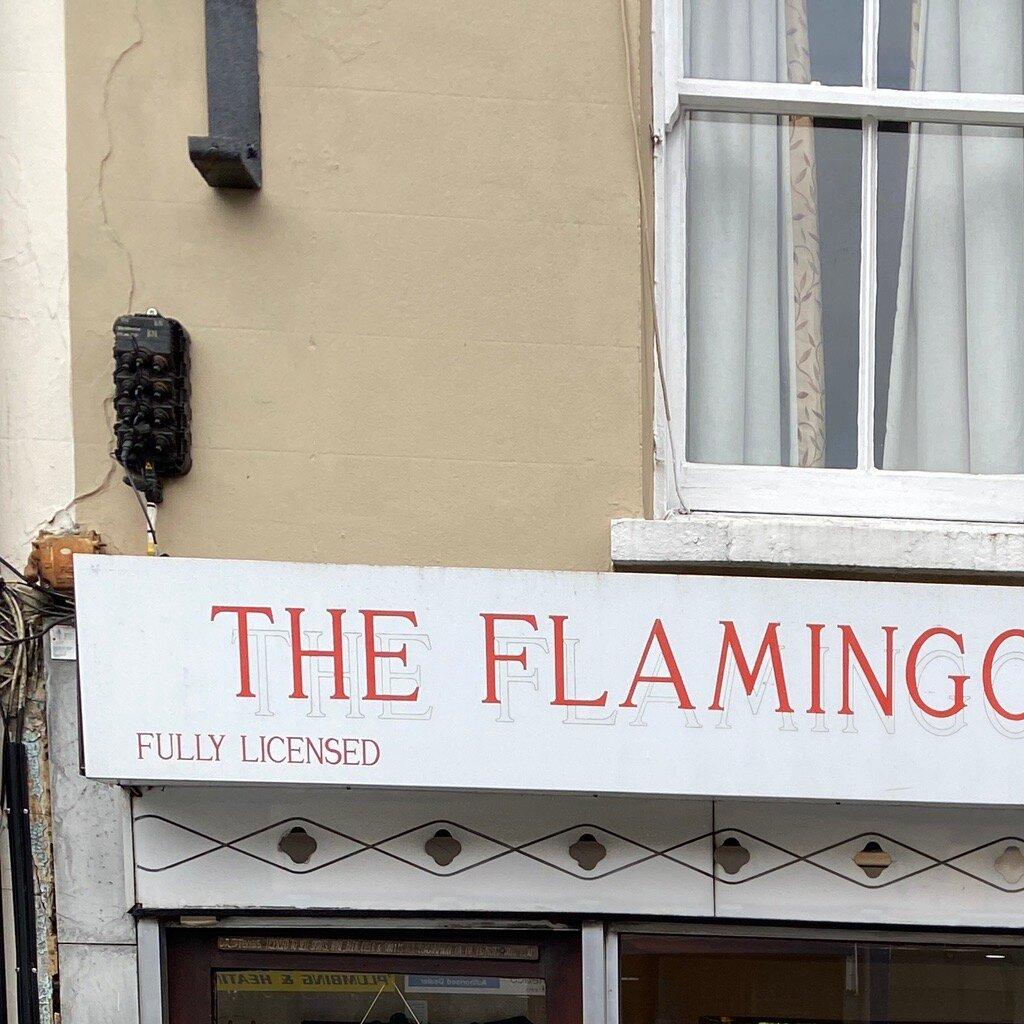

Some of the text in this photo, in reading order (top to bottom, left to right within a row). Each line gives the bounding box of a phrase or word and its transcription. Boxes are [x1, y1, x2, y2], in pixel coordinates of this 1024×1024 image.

[211, 605, 420, 702] THE
[136, 732, 381, 767] FULLY LICENSED
